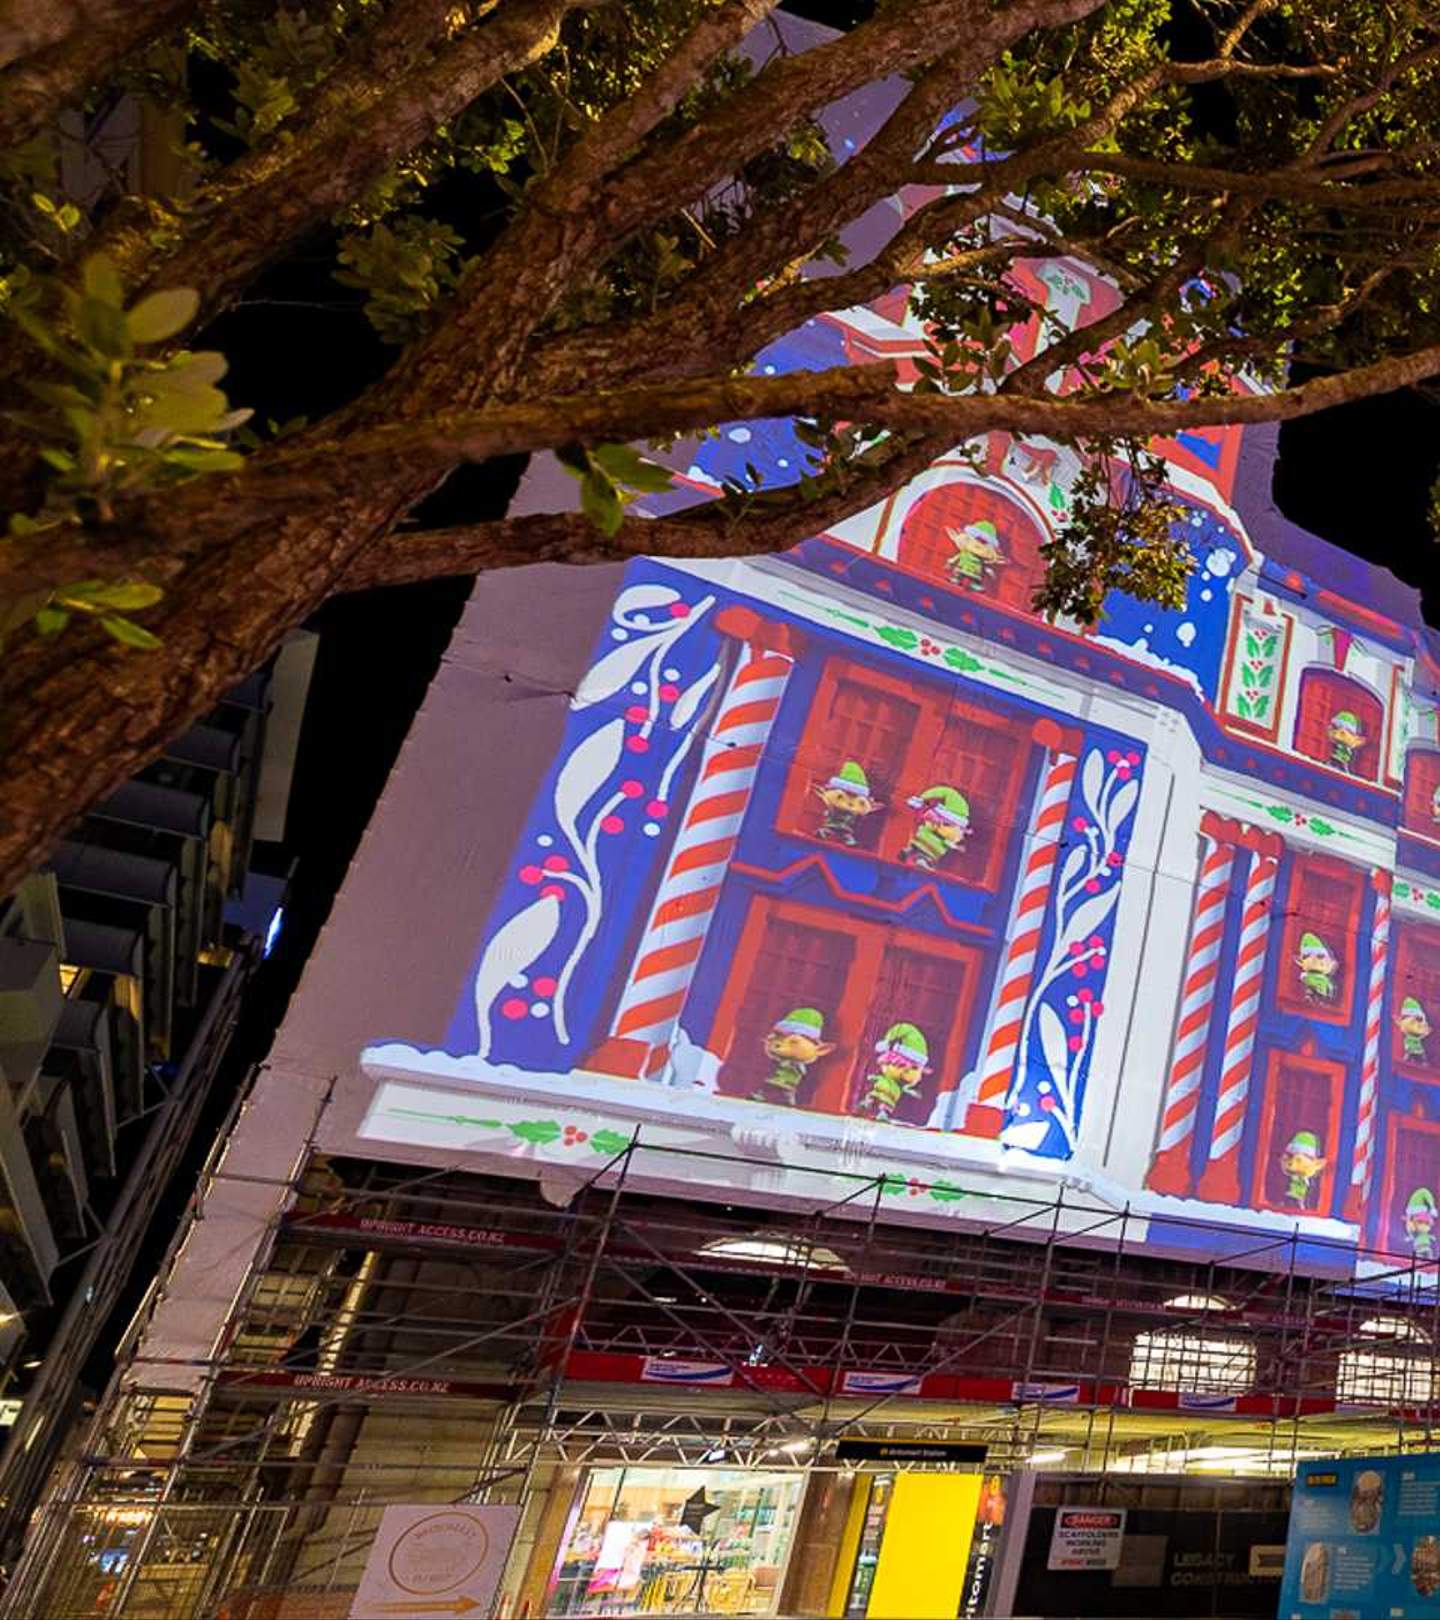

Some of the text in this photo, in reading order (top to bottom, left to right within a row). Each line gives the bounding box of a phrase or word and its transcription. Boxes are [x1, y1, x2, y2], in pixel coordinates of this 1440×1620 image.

[293, 1374, 353, 1389] UPRIGHT
[1069, 1513, 1112, 1526] DANGER
[1172, 1552, 1236, 1568] LEGACY
